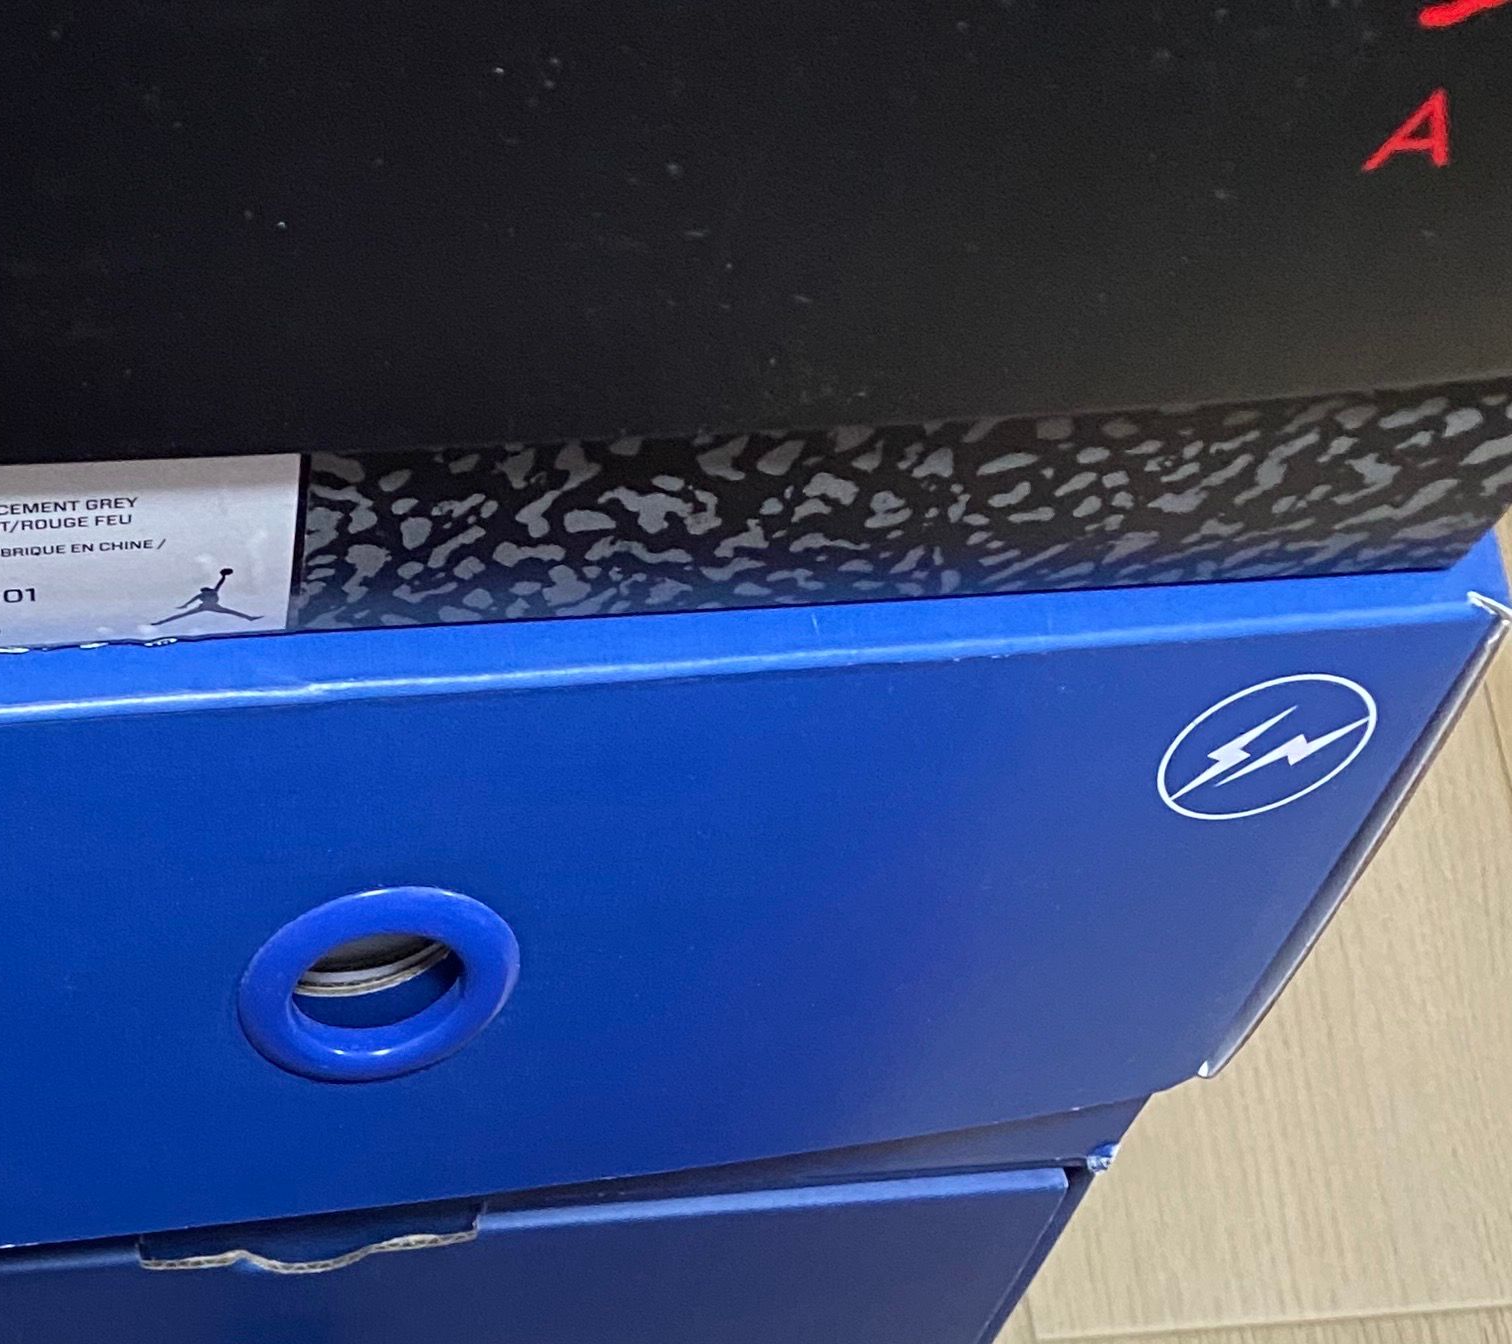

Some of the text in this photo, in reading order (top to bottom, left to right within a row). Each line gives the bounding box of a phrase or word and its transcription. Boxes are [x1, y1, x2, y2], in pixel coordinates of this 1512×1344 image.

[86, 497, 138, 511] GREY
[95, 514, 133, 526] FEU
[71, 543, 94, 554] EN
[99, 539, 153, 551] CHINE
